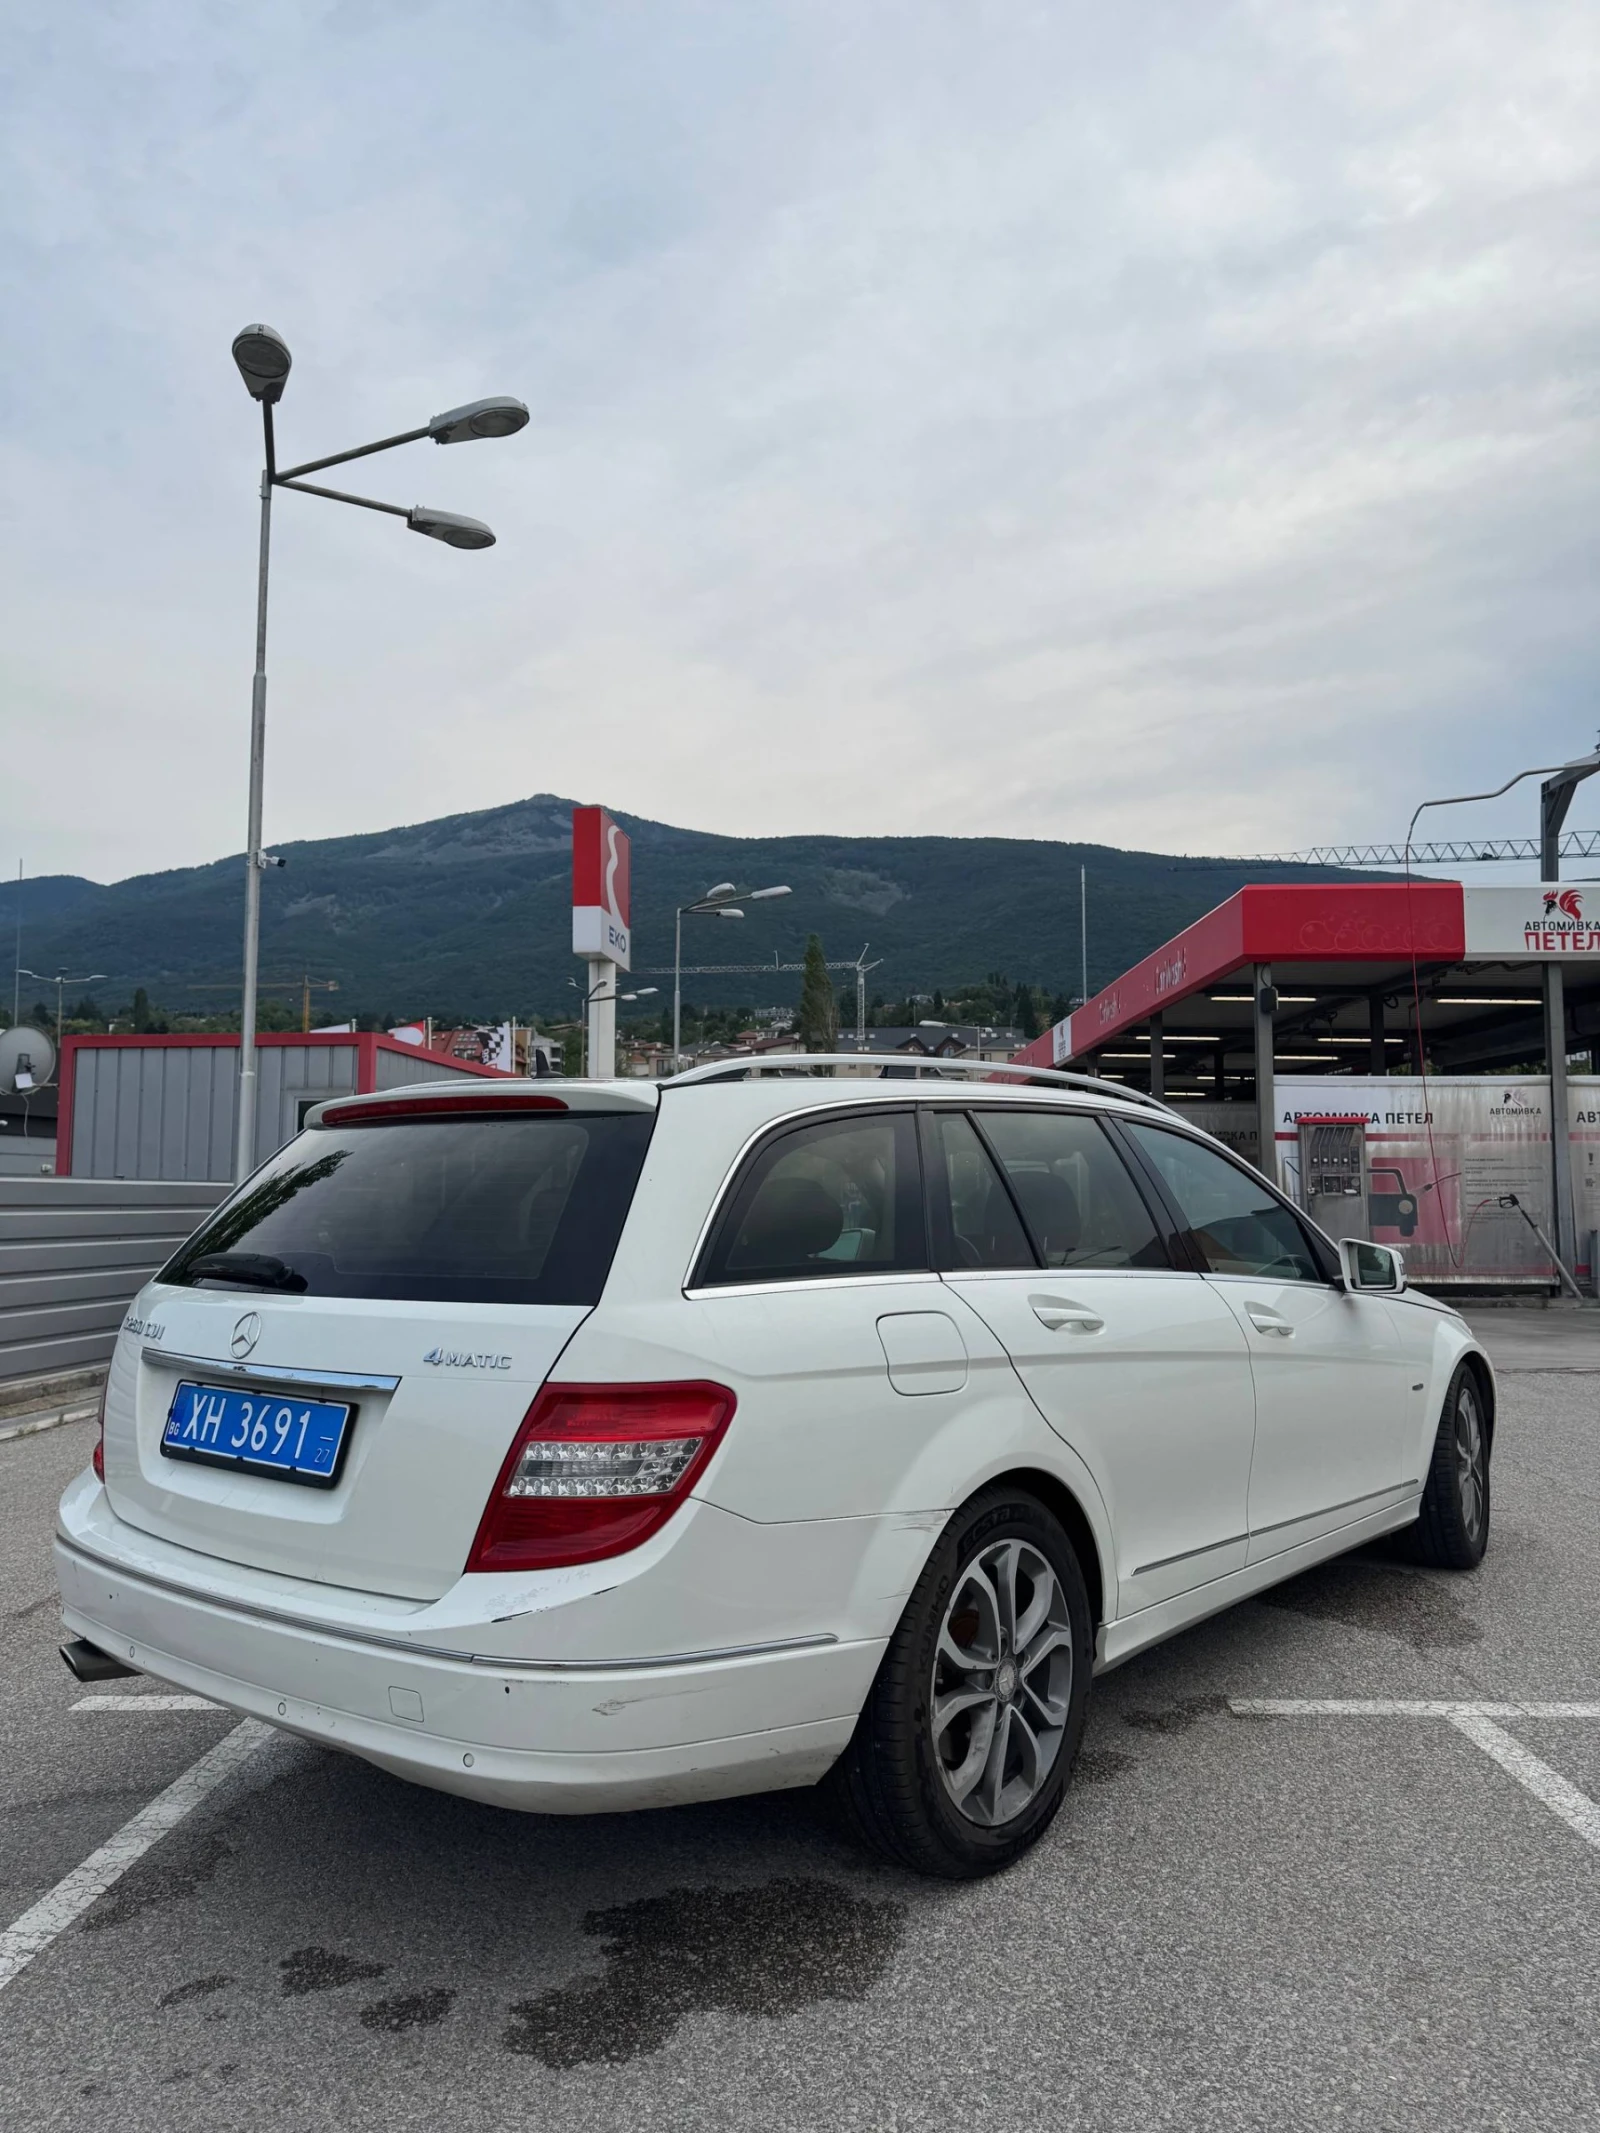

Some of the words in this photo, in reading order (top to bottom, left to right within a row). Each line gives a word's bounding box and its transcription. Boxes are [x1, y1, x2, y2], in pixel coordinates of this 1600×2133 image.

[1524, 921, 1600, 931] АВТОМИВКА
[609, 925, 627, 953] EKO
[1524, 931, 1600, 951] ПЕТЕЛ
[1385, 1112, 1433, 1124] ПЕТЕЛ
[1490, 1107, 1542, 1115] АВТОМИВКА
[423, 1347, 512, 1369] 4MATIC
[168, 1421, 181, 1436] BG
[183, 1393, 227, 1443] XH
[231, 1402, 311, 1459] 3691
[314, 1447, 330, 1464] 27
